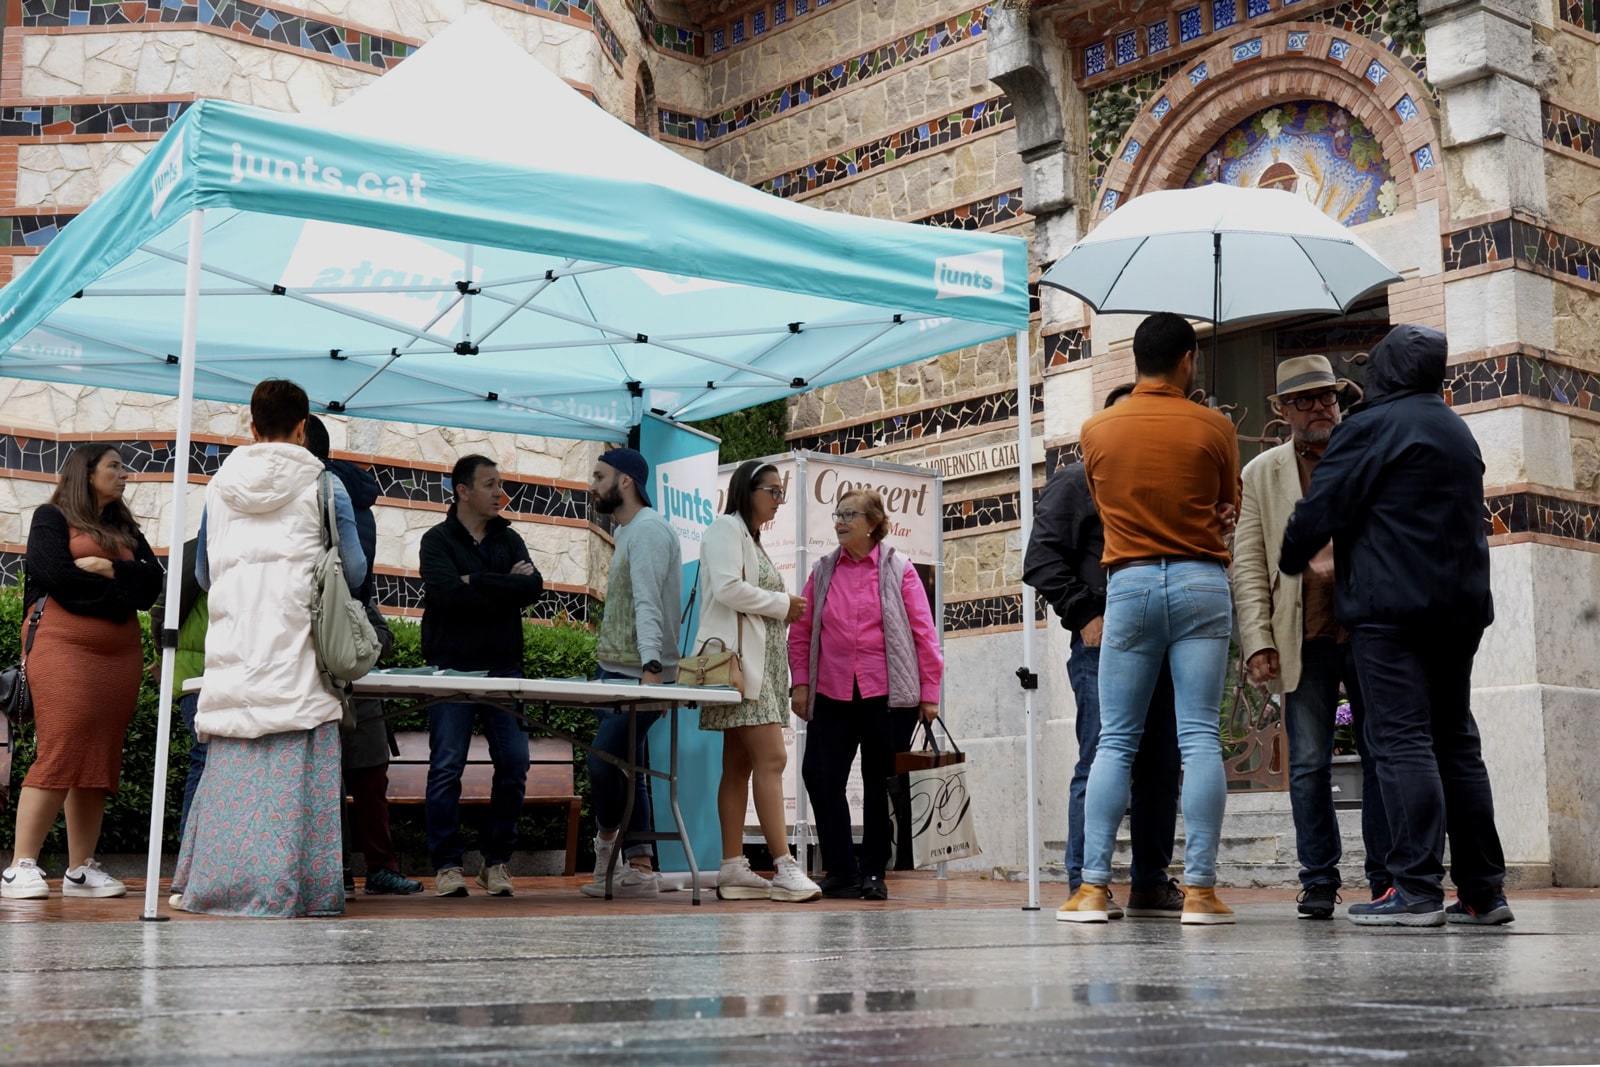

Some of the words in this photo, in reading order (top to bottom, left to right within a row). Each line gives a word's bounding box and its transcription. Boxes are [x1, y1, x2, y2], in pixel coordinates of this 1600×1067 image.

[153, 161, 178, 196] junts
[231, 142, 427, 204] junts.cat
[940, 262, 993, 290] junts
[662, 472, 714, 527] junts
